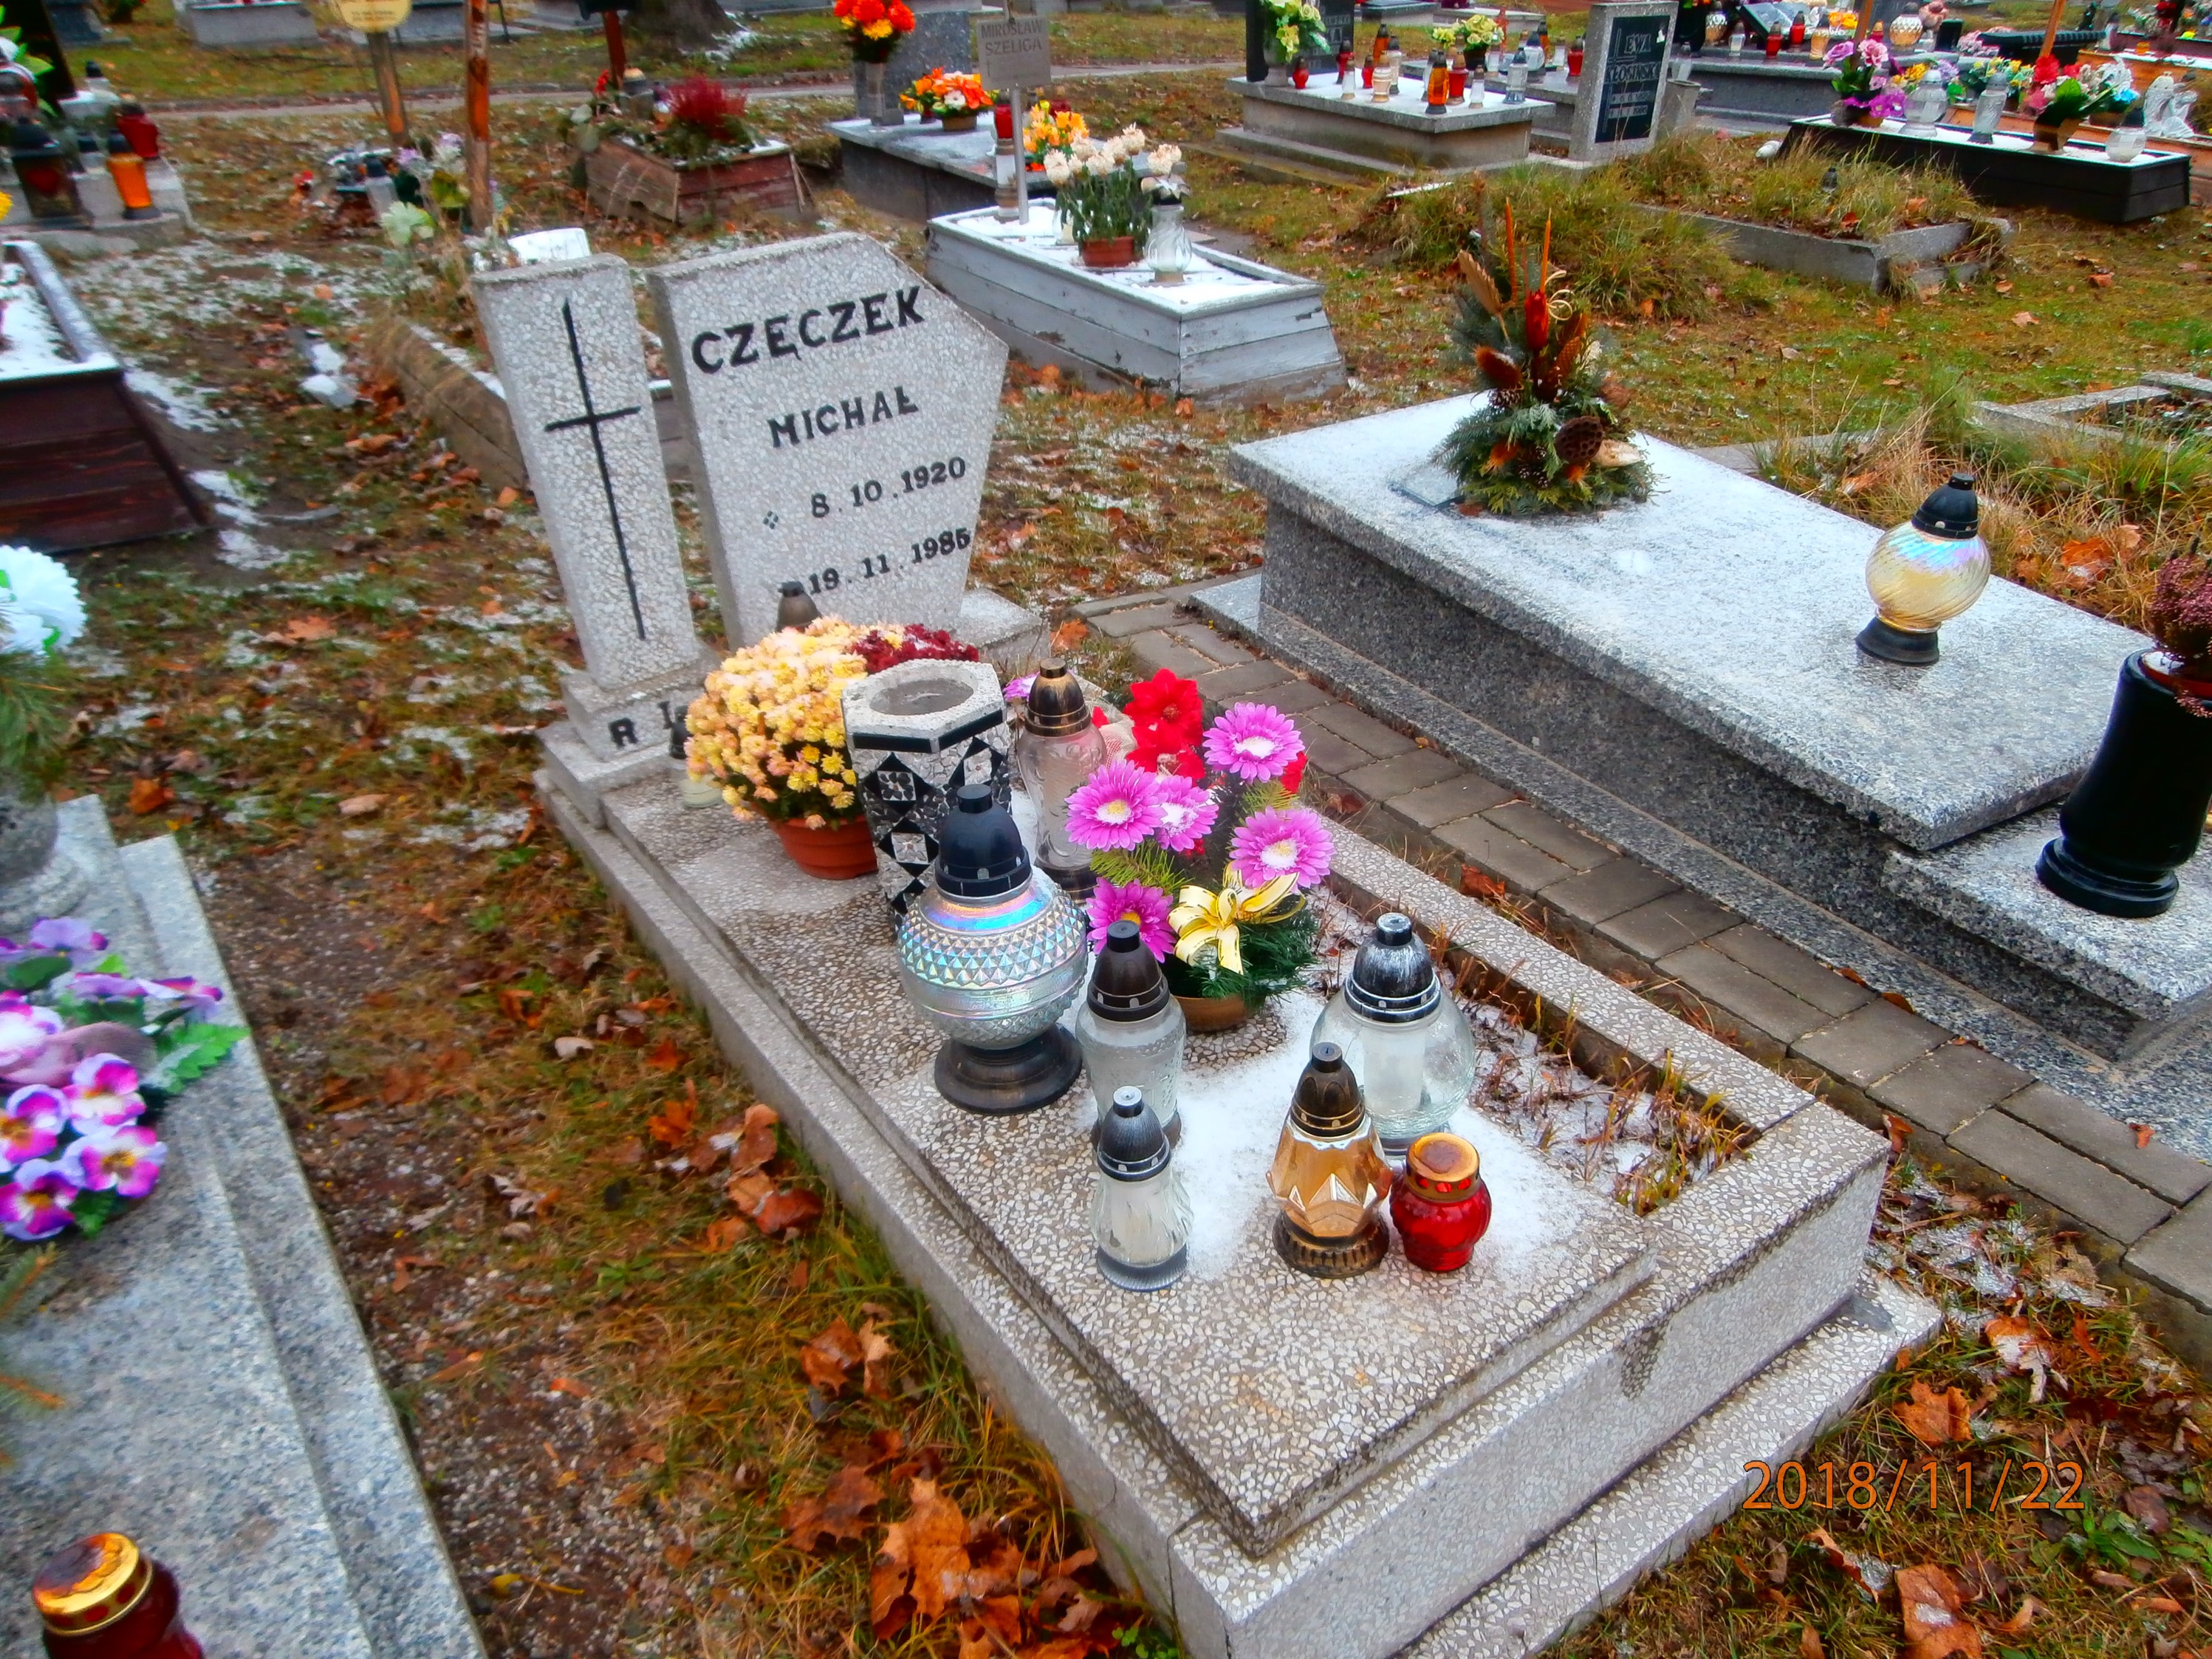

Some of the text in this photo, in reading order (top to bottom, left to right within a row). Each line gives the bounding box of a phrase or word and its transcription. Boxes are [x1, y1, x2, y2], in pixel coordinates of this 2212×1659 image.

[985, 37, 1042, 56] SZELIGA
[1624, 33, 1651, 53] EWA
[691, 285, 925, 374] CZĘCZEK
[767, 386, 919, 448] MICHAŁ
